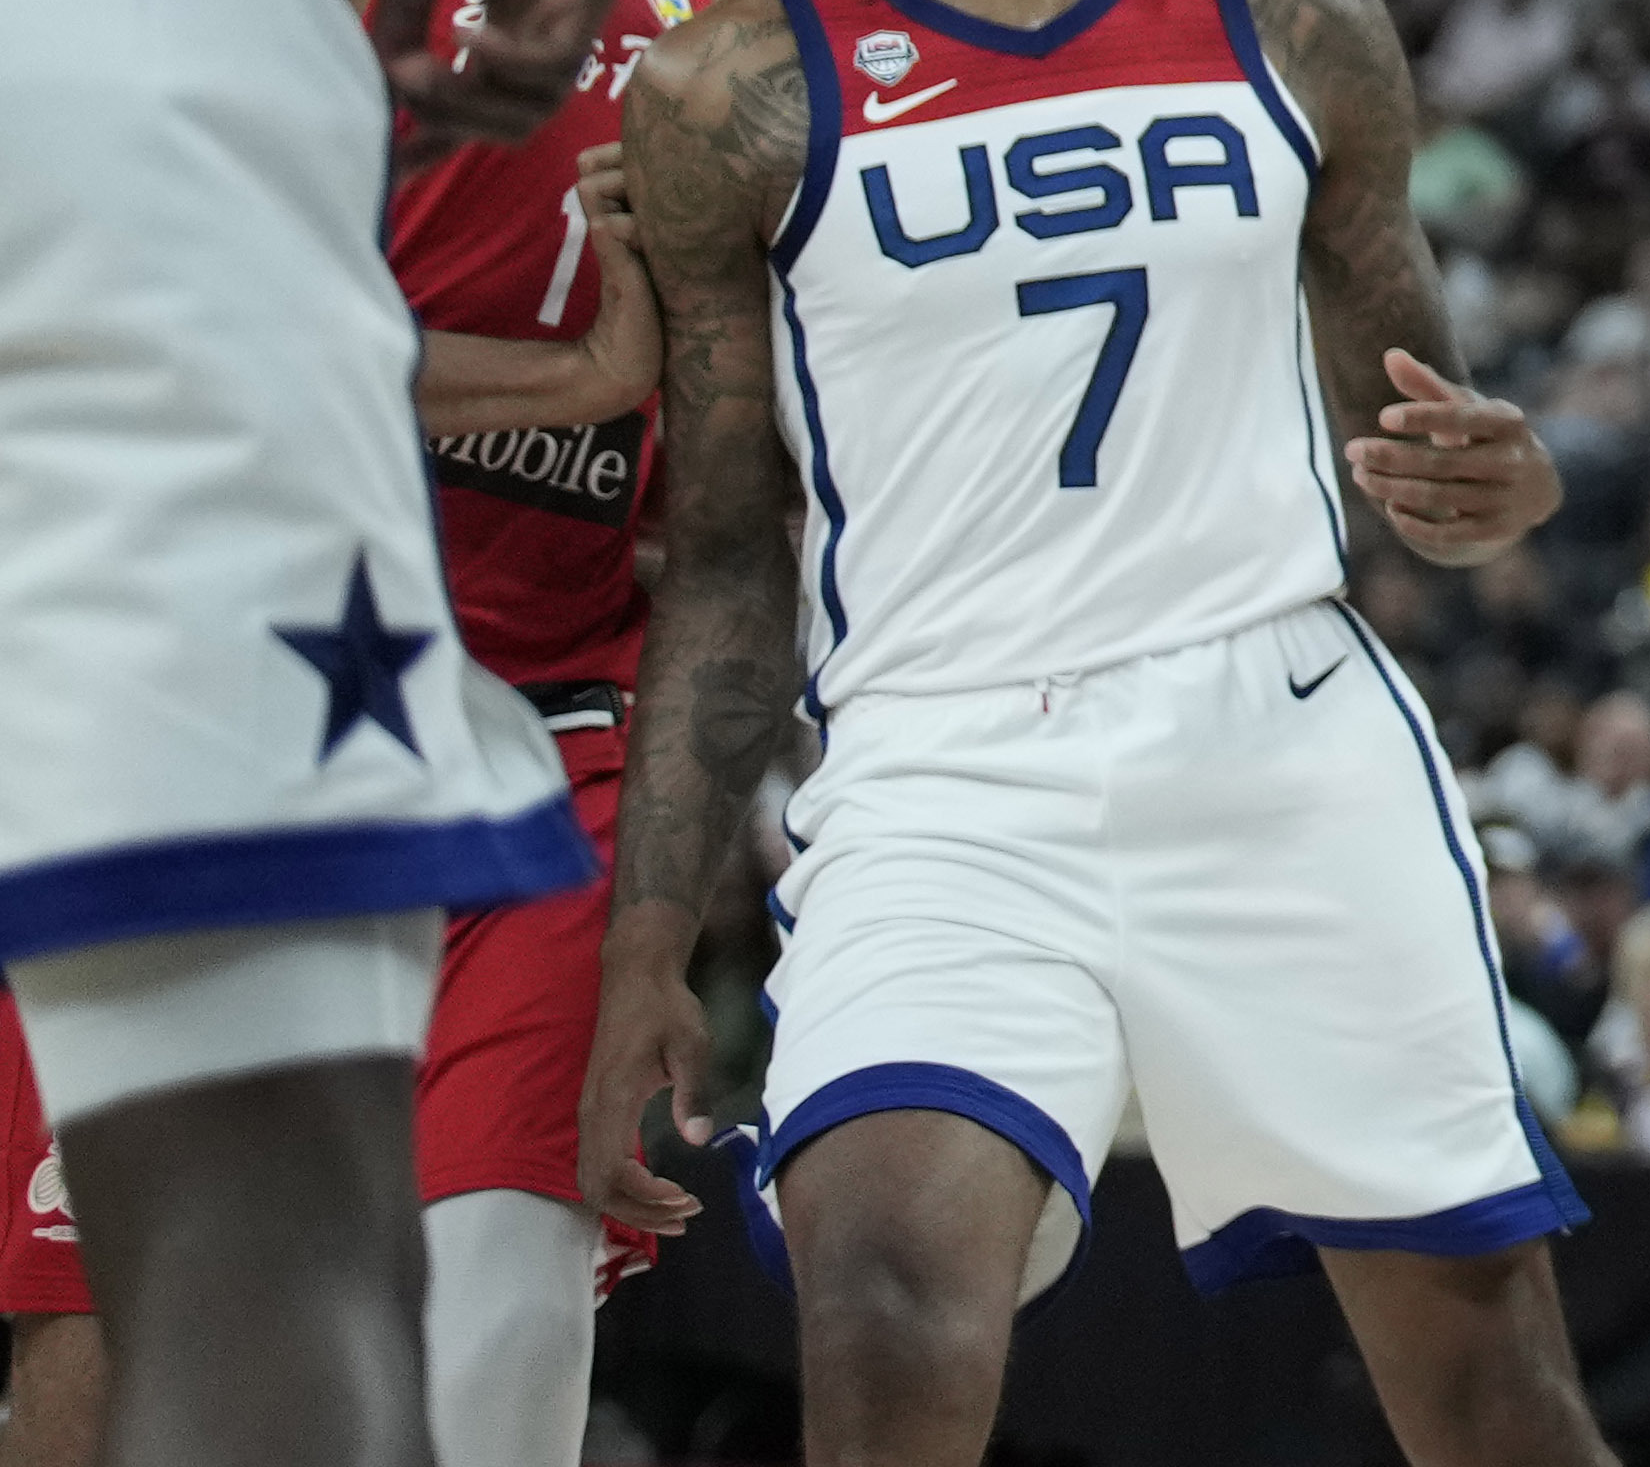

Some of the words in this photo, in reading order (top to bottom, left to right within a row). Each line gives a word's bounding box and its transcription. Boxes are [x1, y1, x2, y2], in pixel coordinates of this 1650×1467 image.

[860, 114, 1260, 269] USA
[1016, 264, 1149, 489] 7
[426, 423, 628, 501] obile
